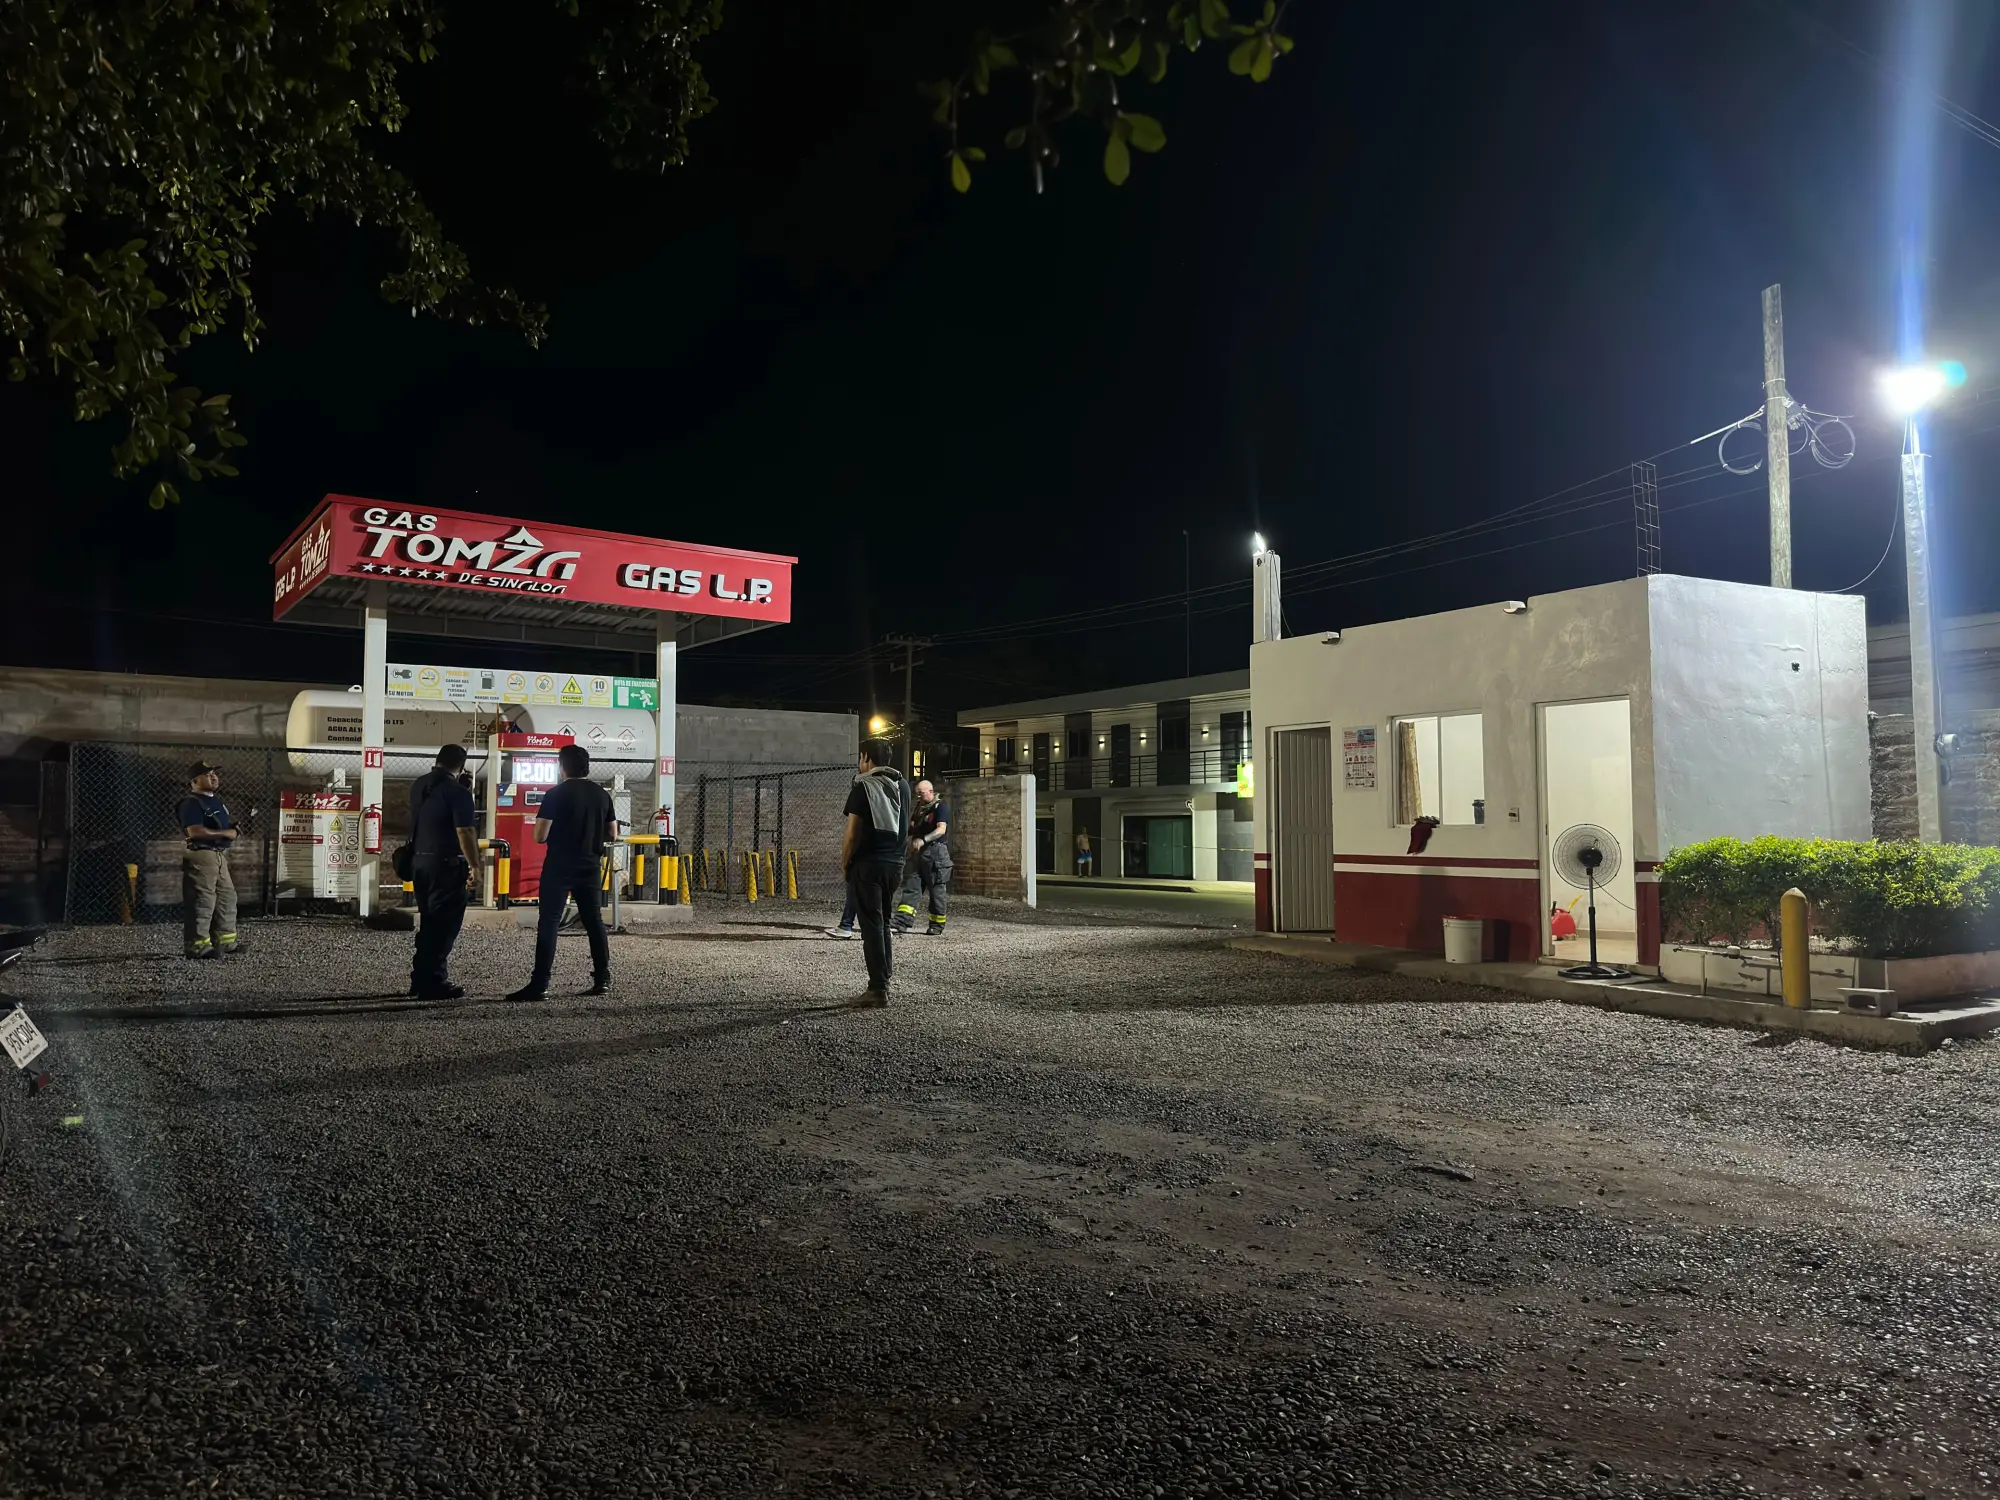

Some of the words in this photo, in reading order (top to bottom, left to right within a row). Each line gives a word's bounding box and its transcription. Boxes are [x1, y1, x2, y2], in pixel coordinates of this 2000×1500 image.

[364, 507, 438, 531] GAS
[301, 533, 312, 555] GAS
[366, 526, 581, 580] TOMZA
[275, 575, 286, 602] GAS
[458, 572, 483, 584] DE
[487, 576, 567, 594] SINALOA
[624, 563, 702, 594] GAS
[716, 573, 773, 603] L.P.
[594, 680, 604, 690] 10
[327, 716, 363, 724] Capacida
[516, 762, 555, 783] 12.00
[295, 797, 351, 810] TOMZA
[283, 825, 300, 833] LITRO
